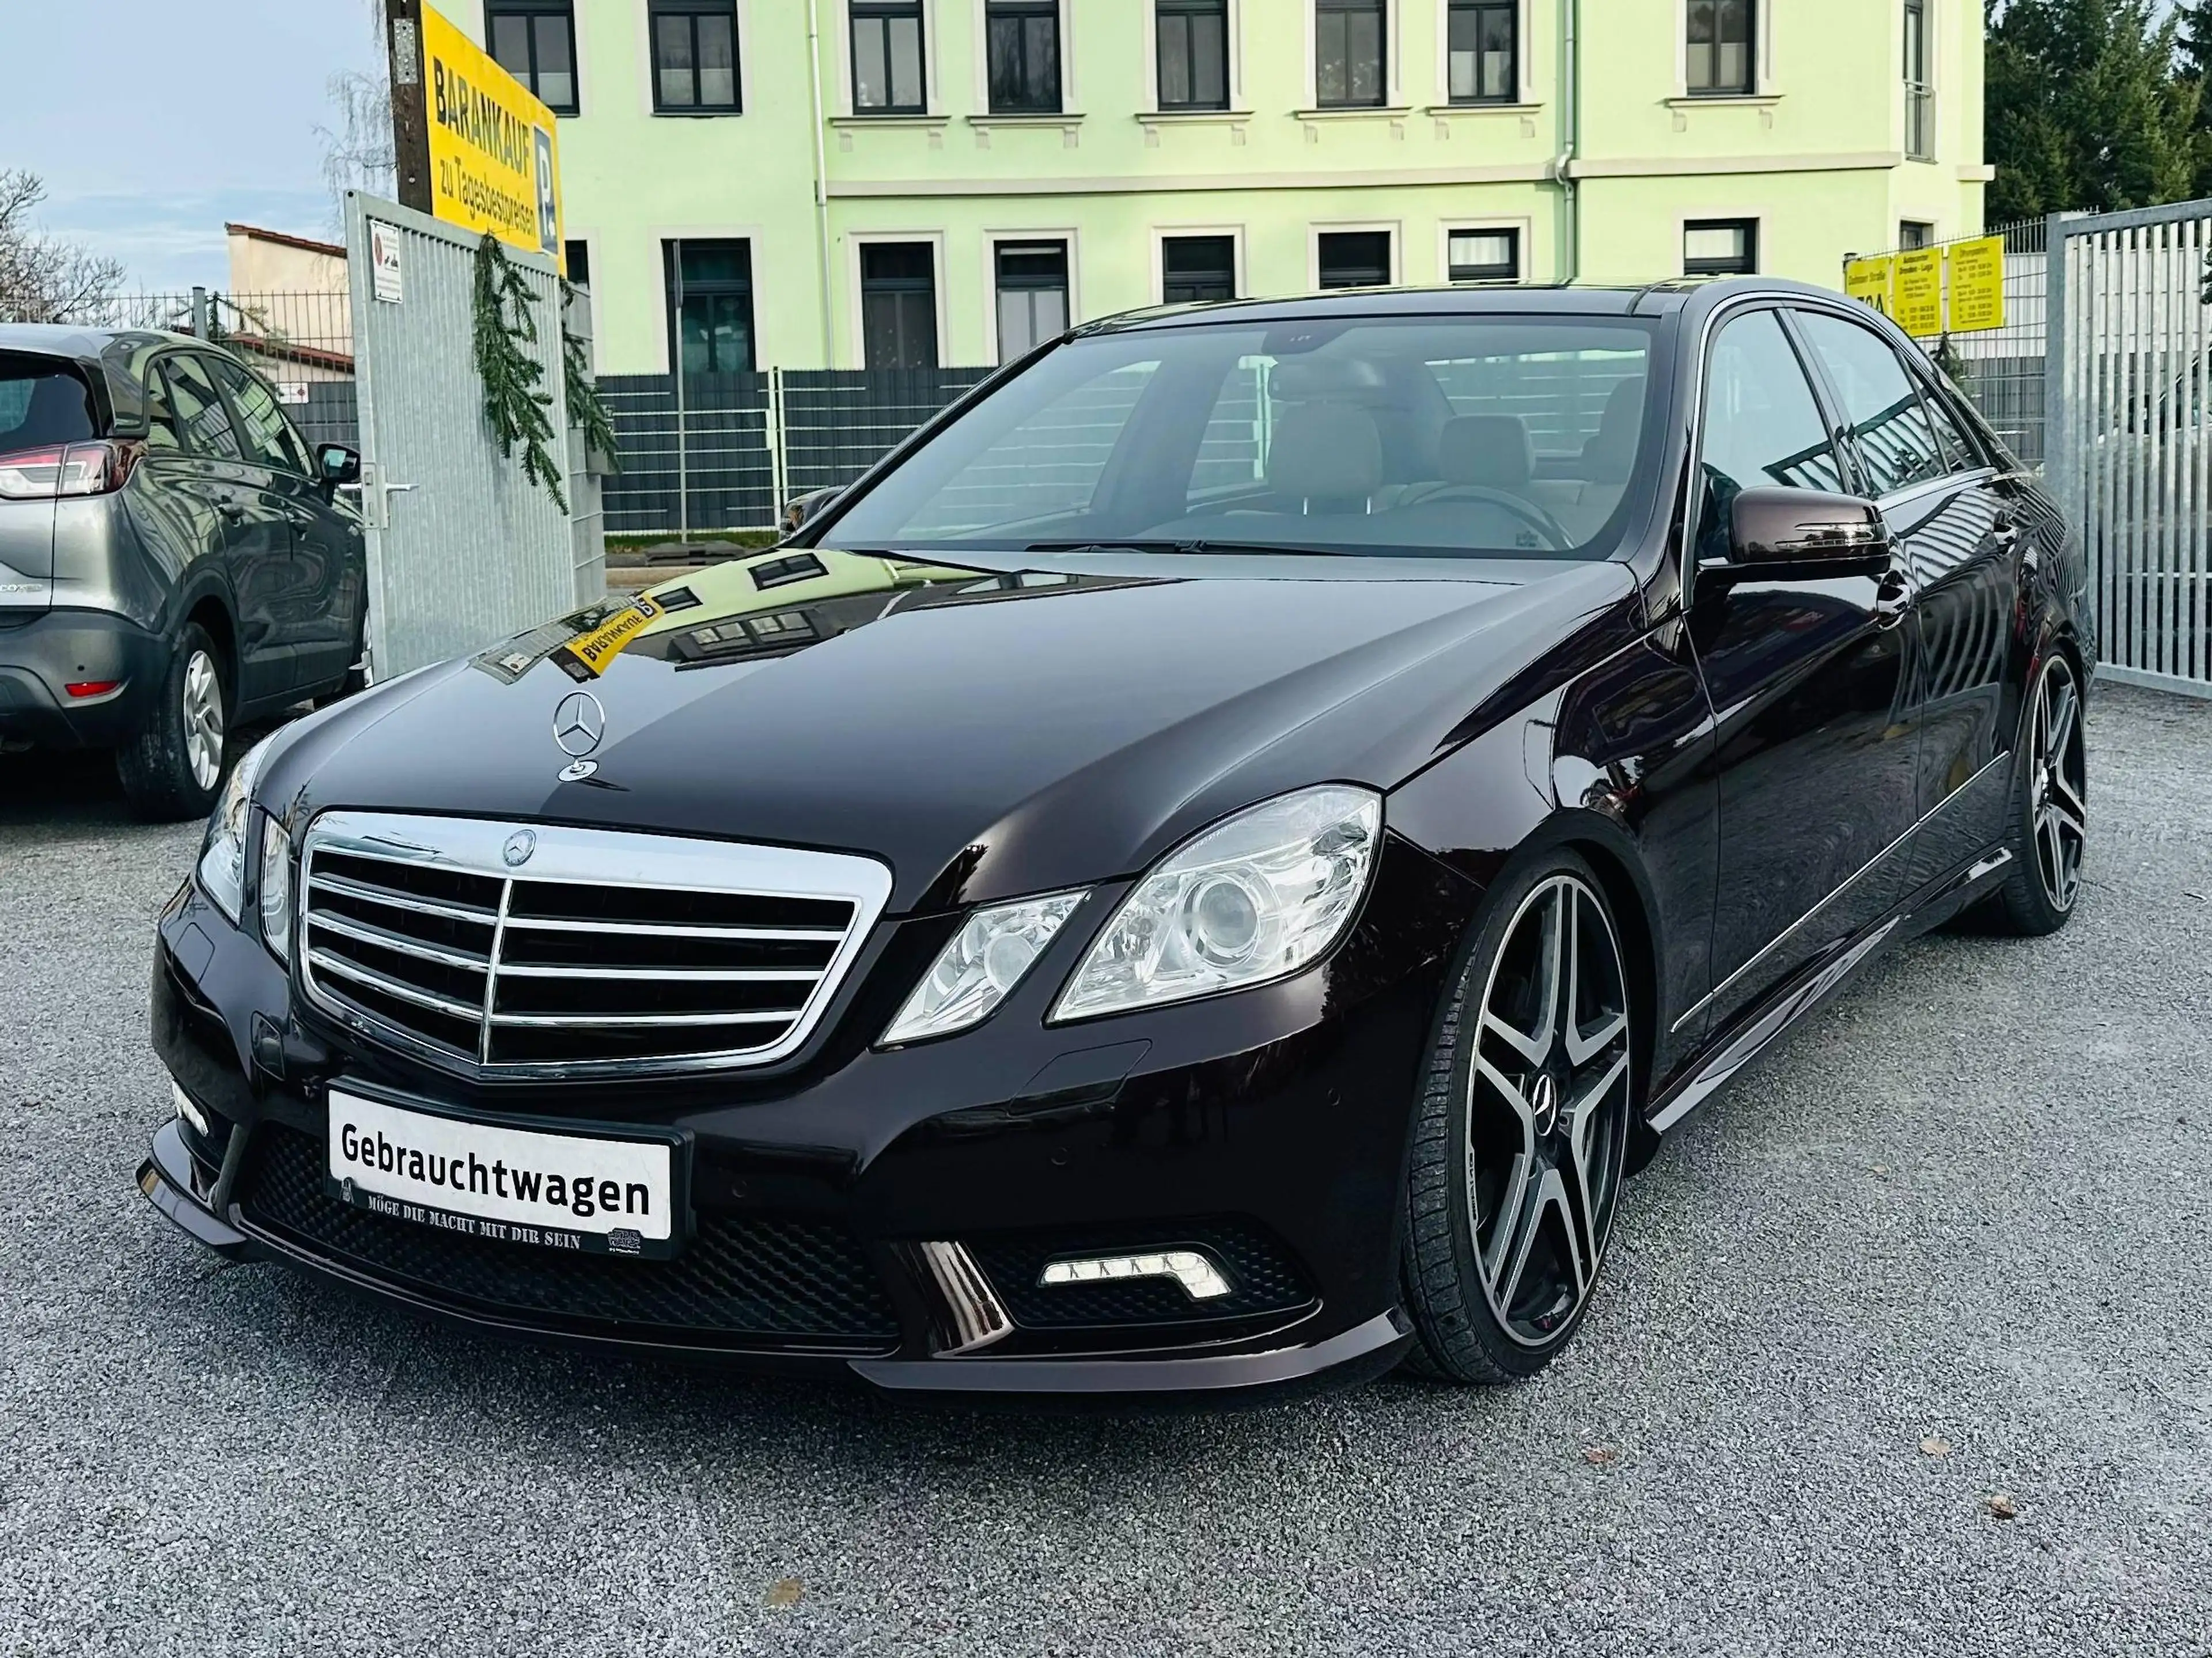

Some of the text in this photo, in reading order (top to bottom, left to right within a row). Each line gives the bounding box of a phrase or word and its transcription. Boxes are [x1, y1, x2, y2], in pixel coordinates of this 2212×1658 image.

[434, 56, 529, 179] BARANKAUF
[441, 155, 536, 238] zu Tagesbestpreisen
[539, 145, 551, 237] P
[342, 1123, 649, 1217] Gebrauchtwagen
[368, 1194, 581, 1250] MÖGE DIE MACHT MIT DIR SEIN
